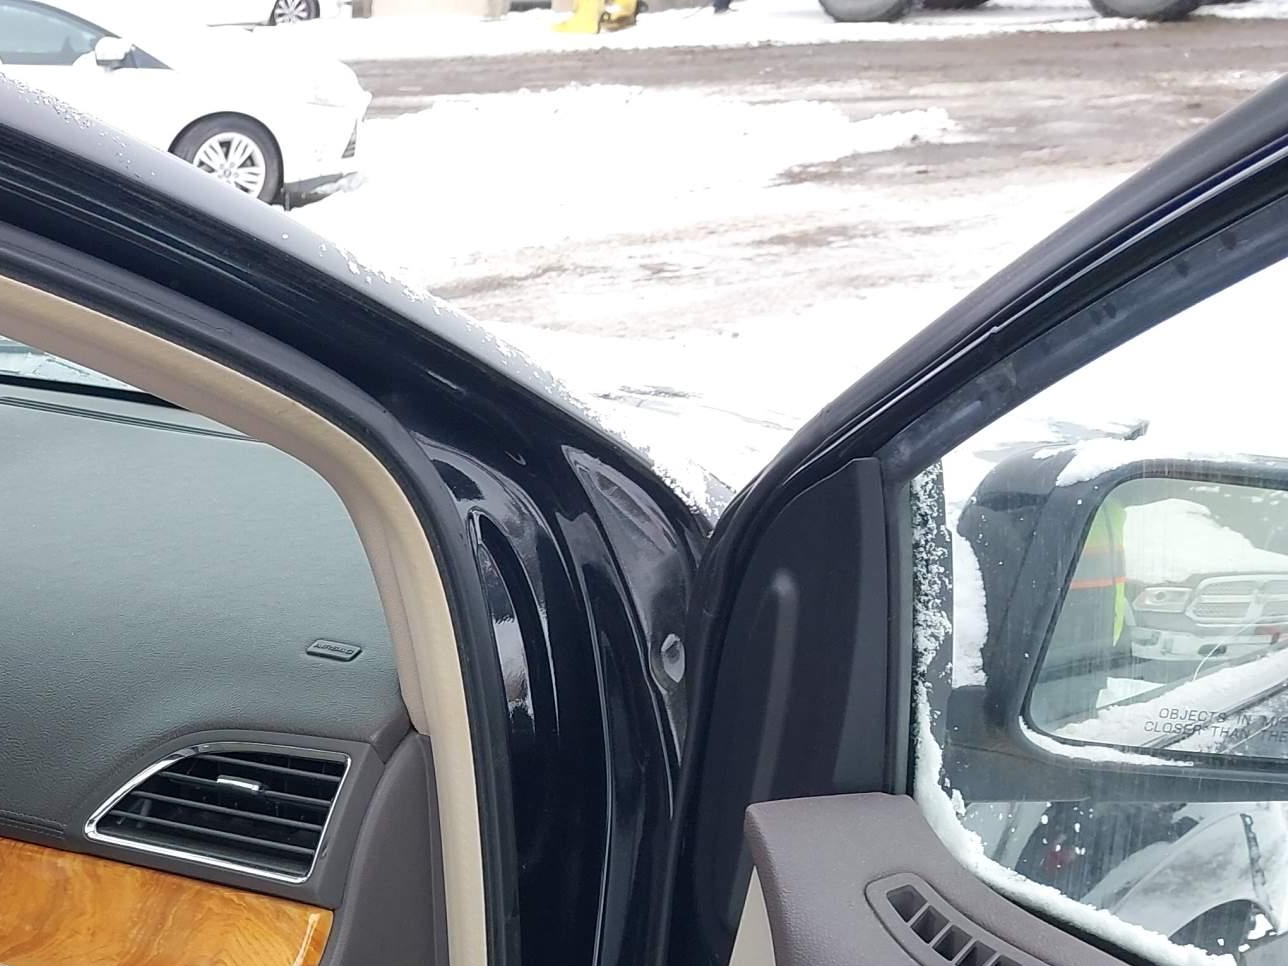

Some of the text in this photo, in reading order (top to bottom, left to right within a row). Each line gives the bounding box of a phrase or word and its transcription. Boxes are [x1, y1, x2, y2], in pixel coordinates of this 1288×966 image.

[1158, 707, 1227, 723] OBJECTS
[1143, 721, 1202, 736] CLOSER
[1211, 725, 1254, 740] THAN
